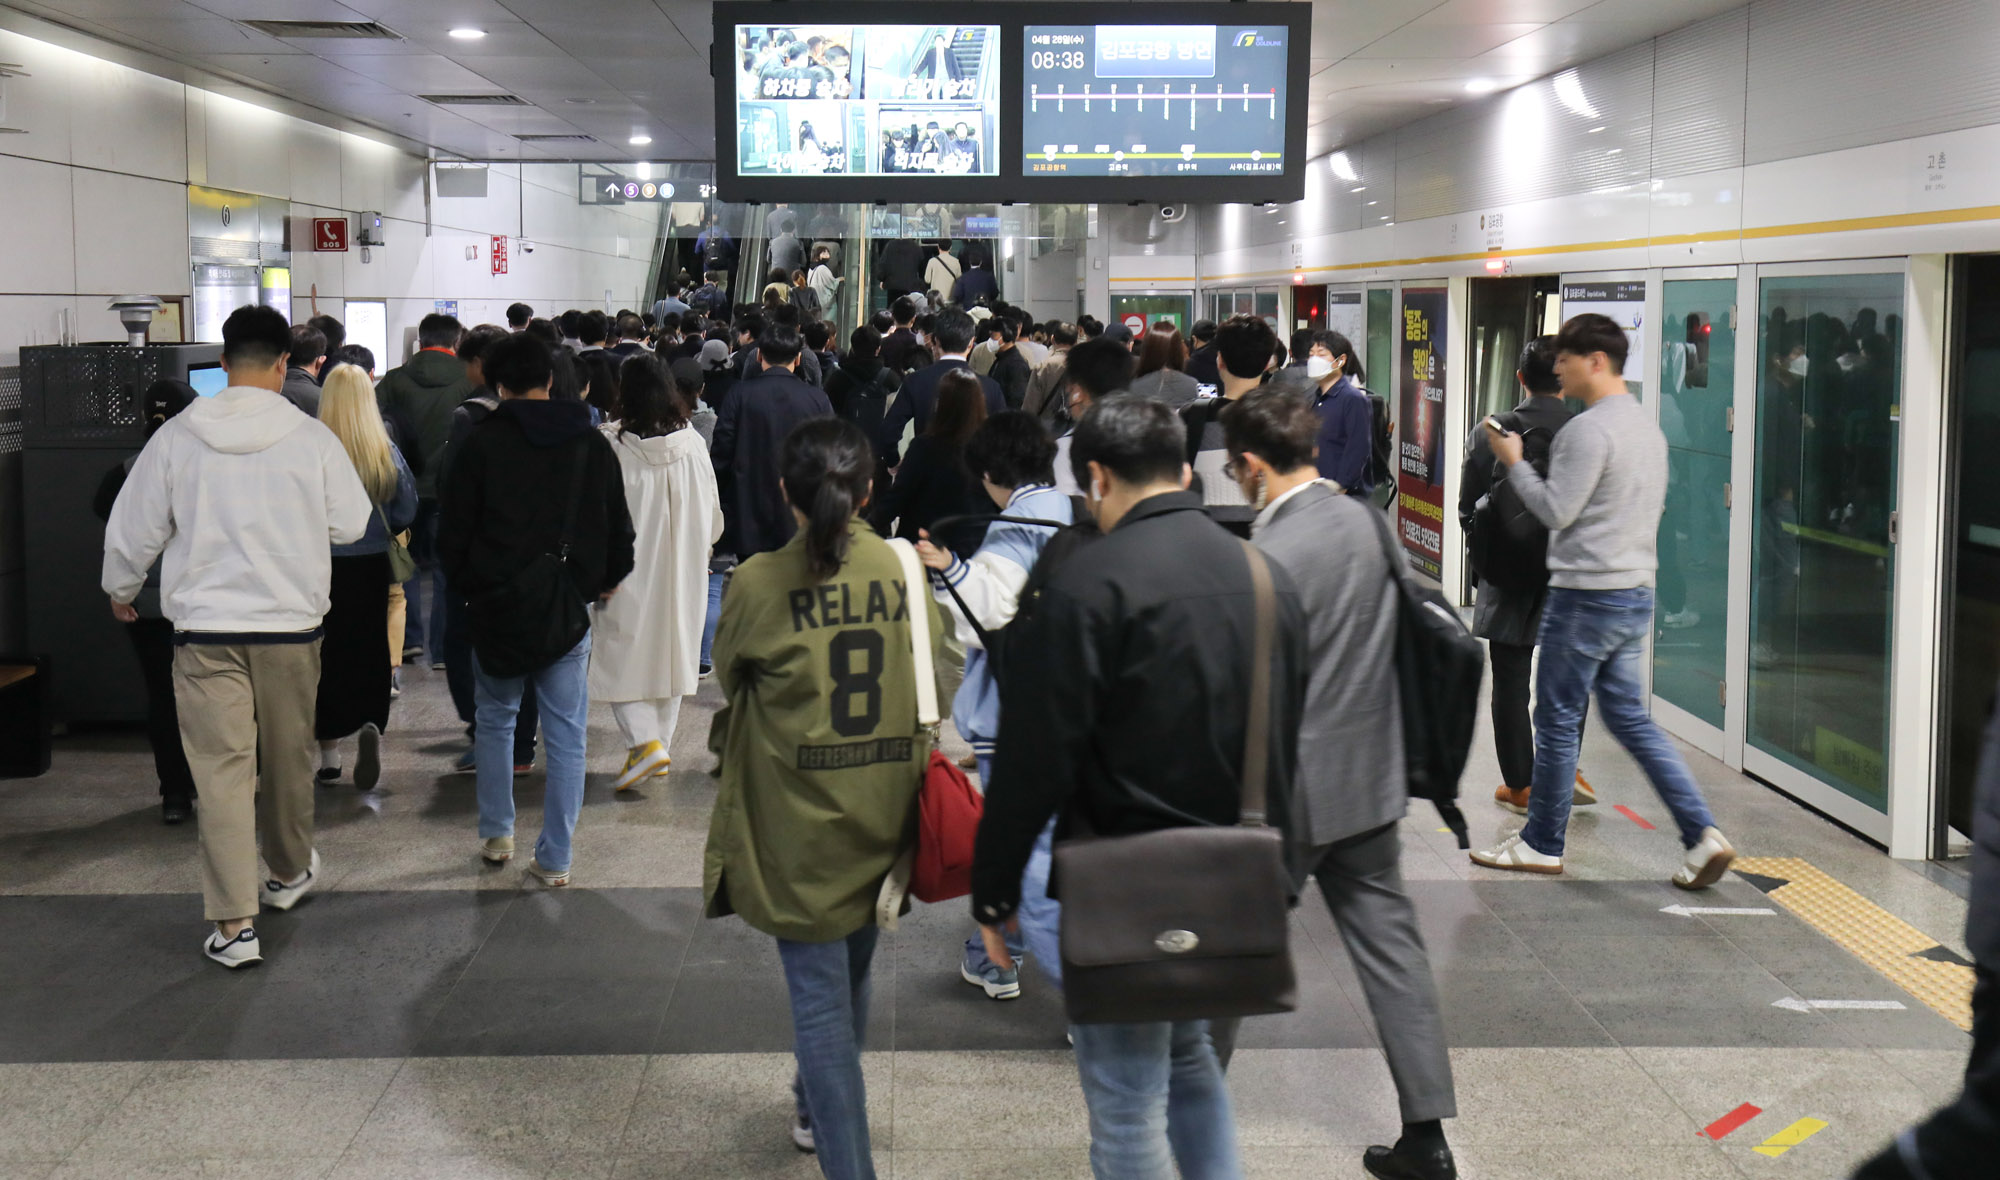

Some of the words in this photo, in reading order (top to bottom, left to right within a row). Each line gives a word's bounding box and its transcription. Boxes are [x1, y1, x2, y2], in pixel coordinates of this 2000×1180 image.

[1032, 51, 1084, 69] 08:38
[1101, 40, 1172, 60] 김포공항
[1177, 40, 1212, 60] 방면
[788, 580, 910, 632] RELAX
[829, 628, 884, 737] 8
